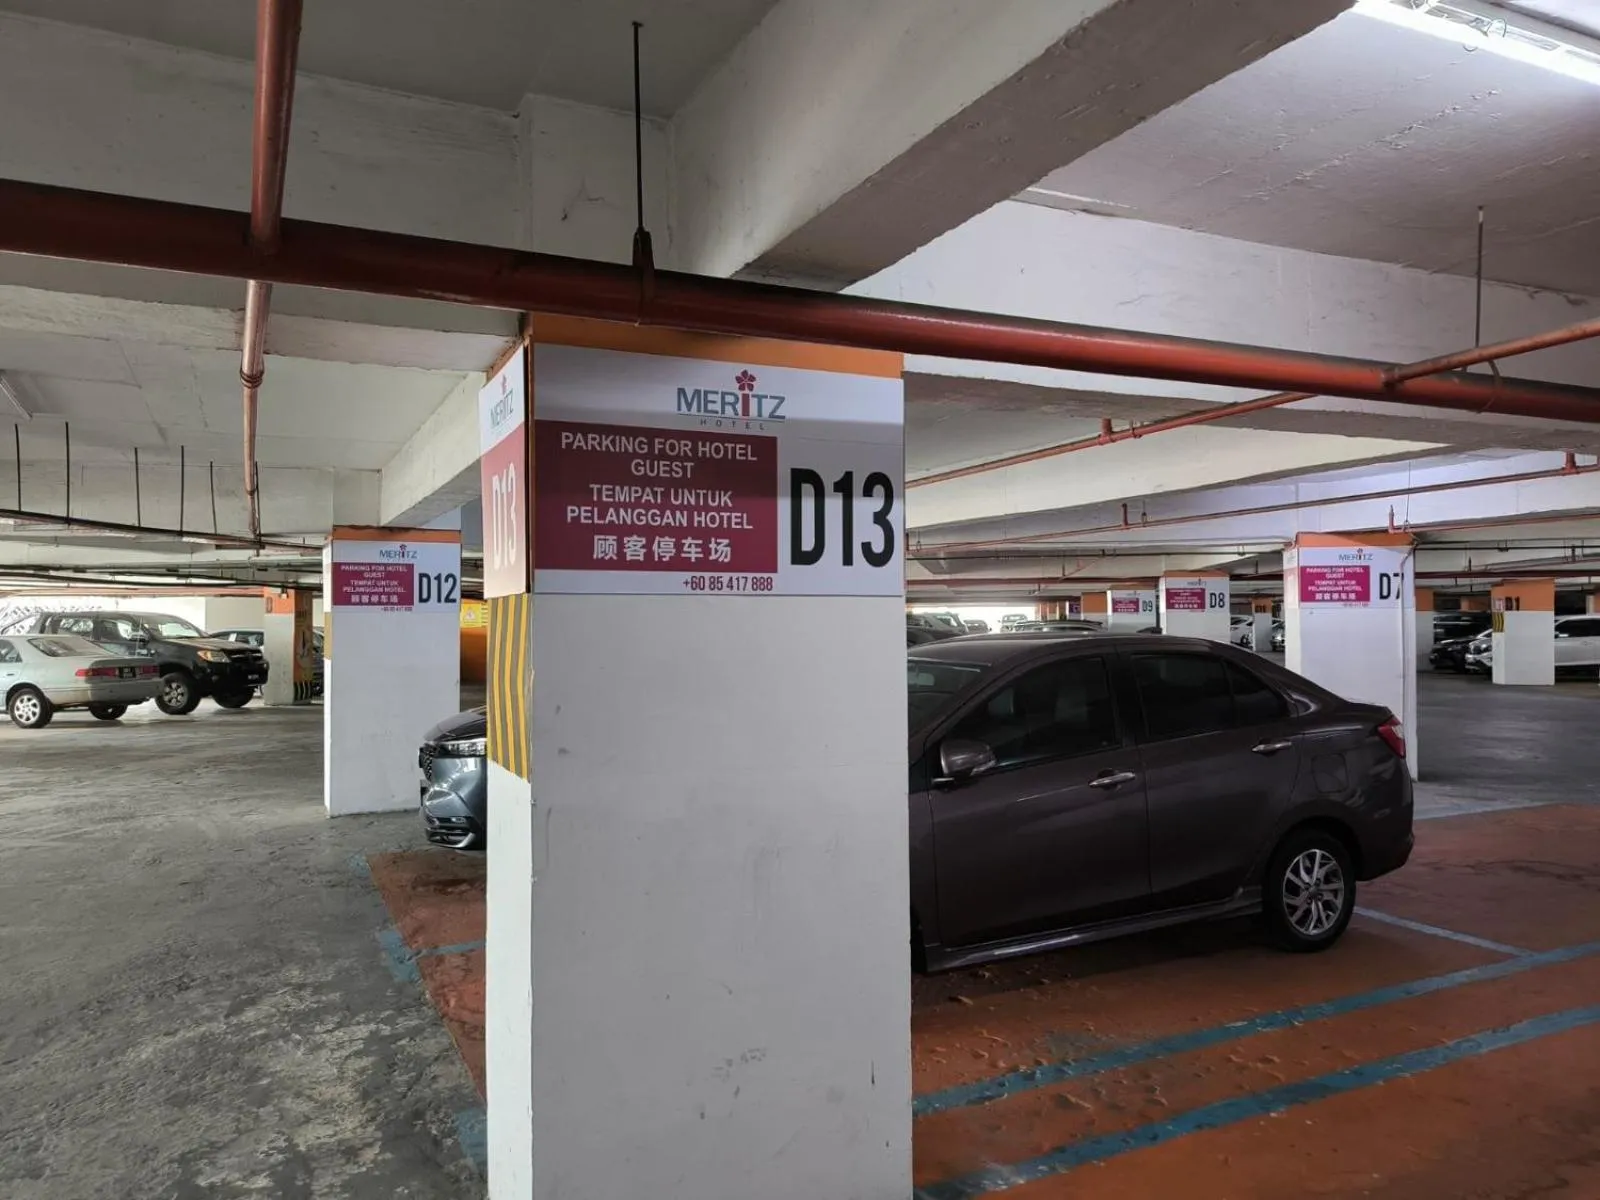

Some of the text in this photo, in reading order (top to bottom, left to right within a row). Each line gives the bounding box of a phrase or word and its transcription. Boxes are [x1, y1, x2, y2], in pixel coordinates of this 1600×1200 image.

[701, 419, 765, 430] HOTEL
[561, 432, 758, 460] PARKING FOR HOTEL
[631, 459, 694, 478] GUEST
[590, 484, 733, 507] TEMPAT UNTUK
[492, 463, 516, 570] D13
[567, 506, 753, 529] PELANGGAN HOTEL
[790, 468, 894, 567] D13
[593, 534, 731, 562] 顾客停车场
[418, 573, 457, 603] D12
[683, 575, 773, 591] +60 85 417 888
[1142, 600, 1153, 612] D9
[1210, 592, 1225, 608] D8
